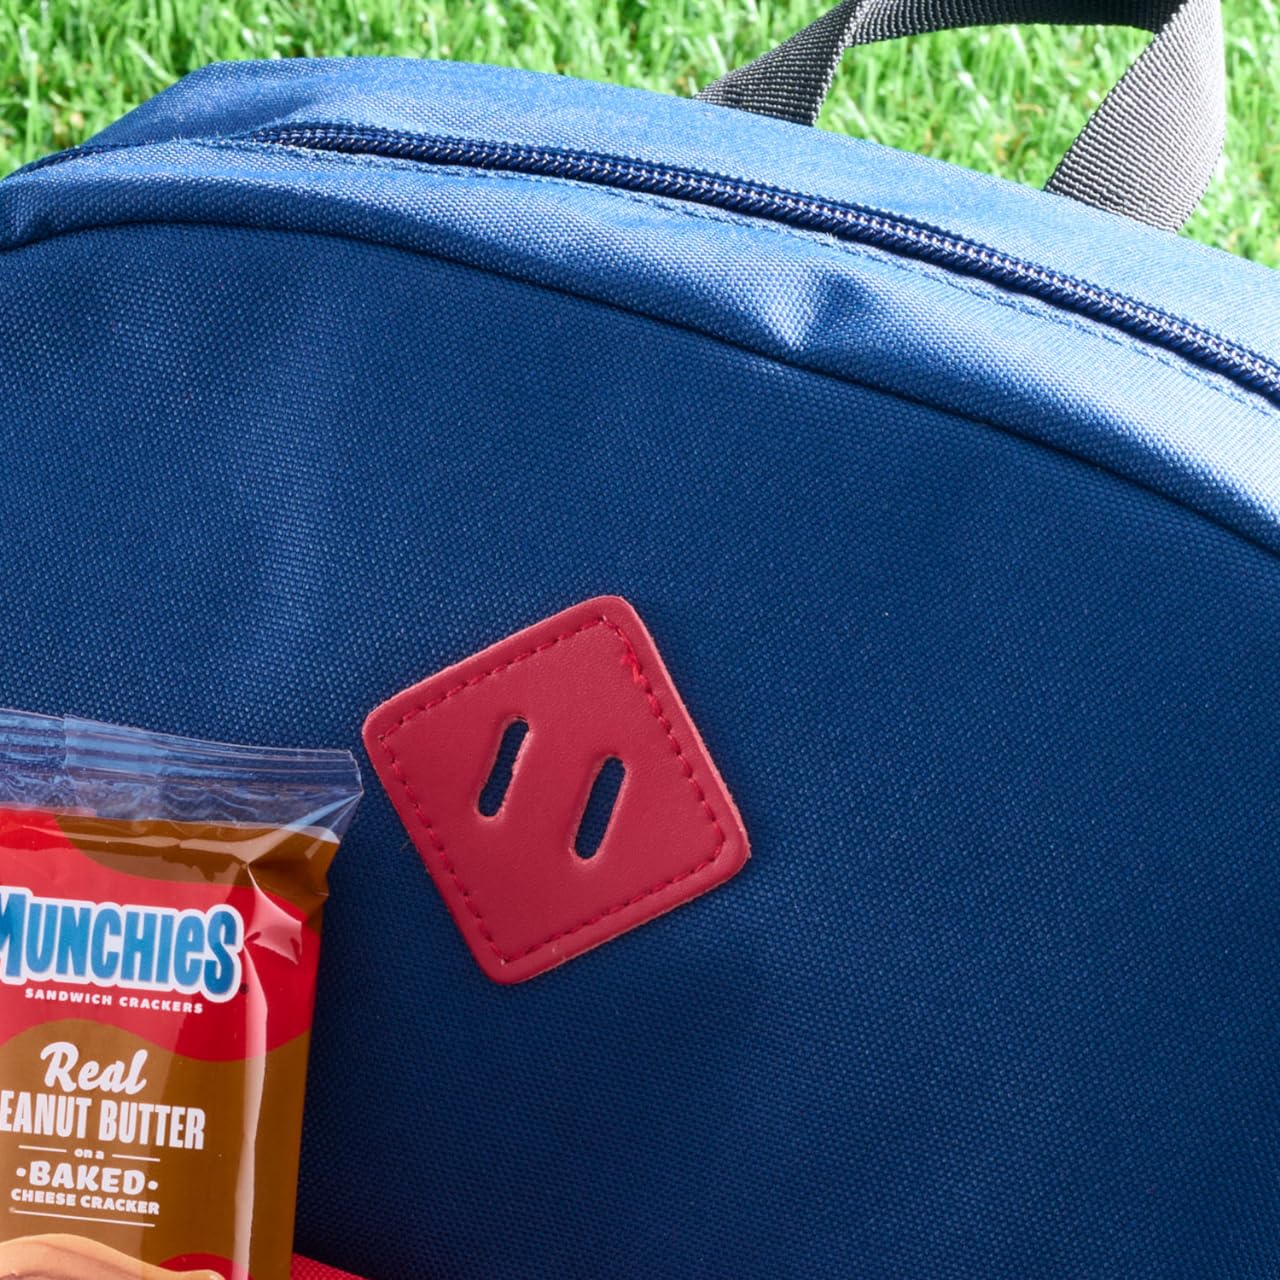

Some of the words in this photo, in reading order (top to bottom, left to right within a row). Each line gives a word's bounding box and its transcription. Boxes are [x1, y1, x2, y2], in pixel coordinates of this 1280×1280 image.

[25, 987, 113, 1006] SANDWICH
[119, 996, 203, 1014] CRACKERS
[39, 1041, 149, 1095] Real
[98, 1100, 206, 1149] BUTTER
[74, 1148, 93, 1159] on
[95, 1150, 104, 1160] a
[10, 1188, 76, 1206] CHEESE
[80, 1195, 160, 1215] CRACKER
